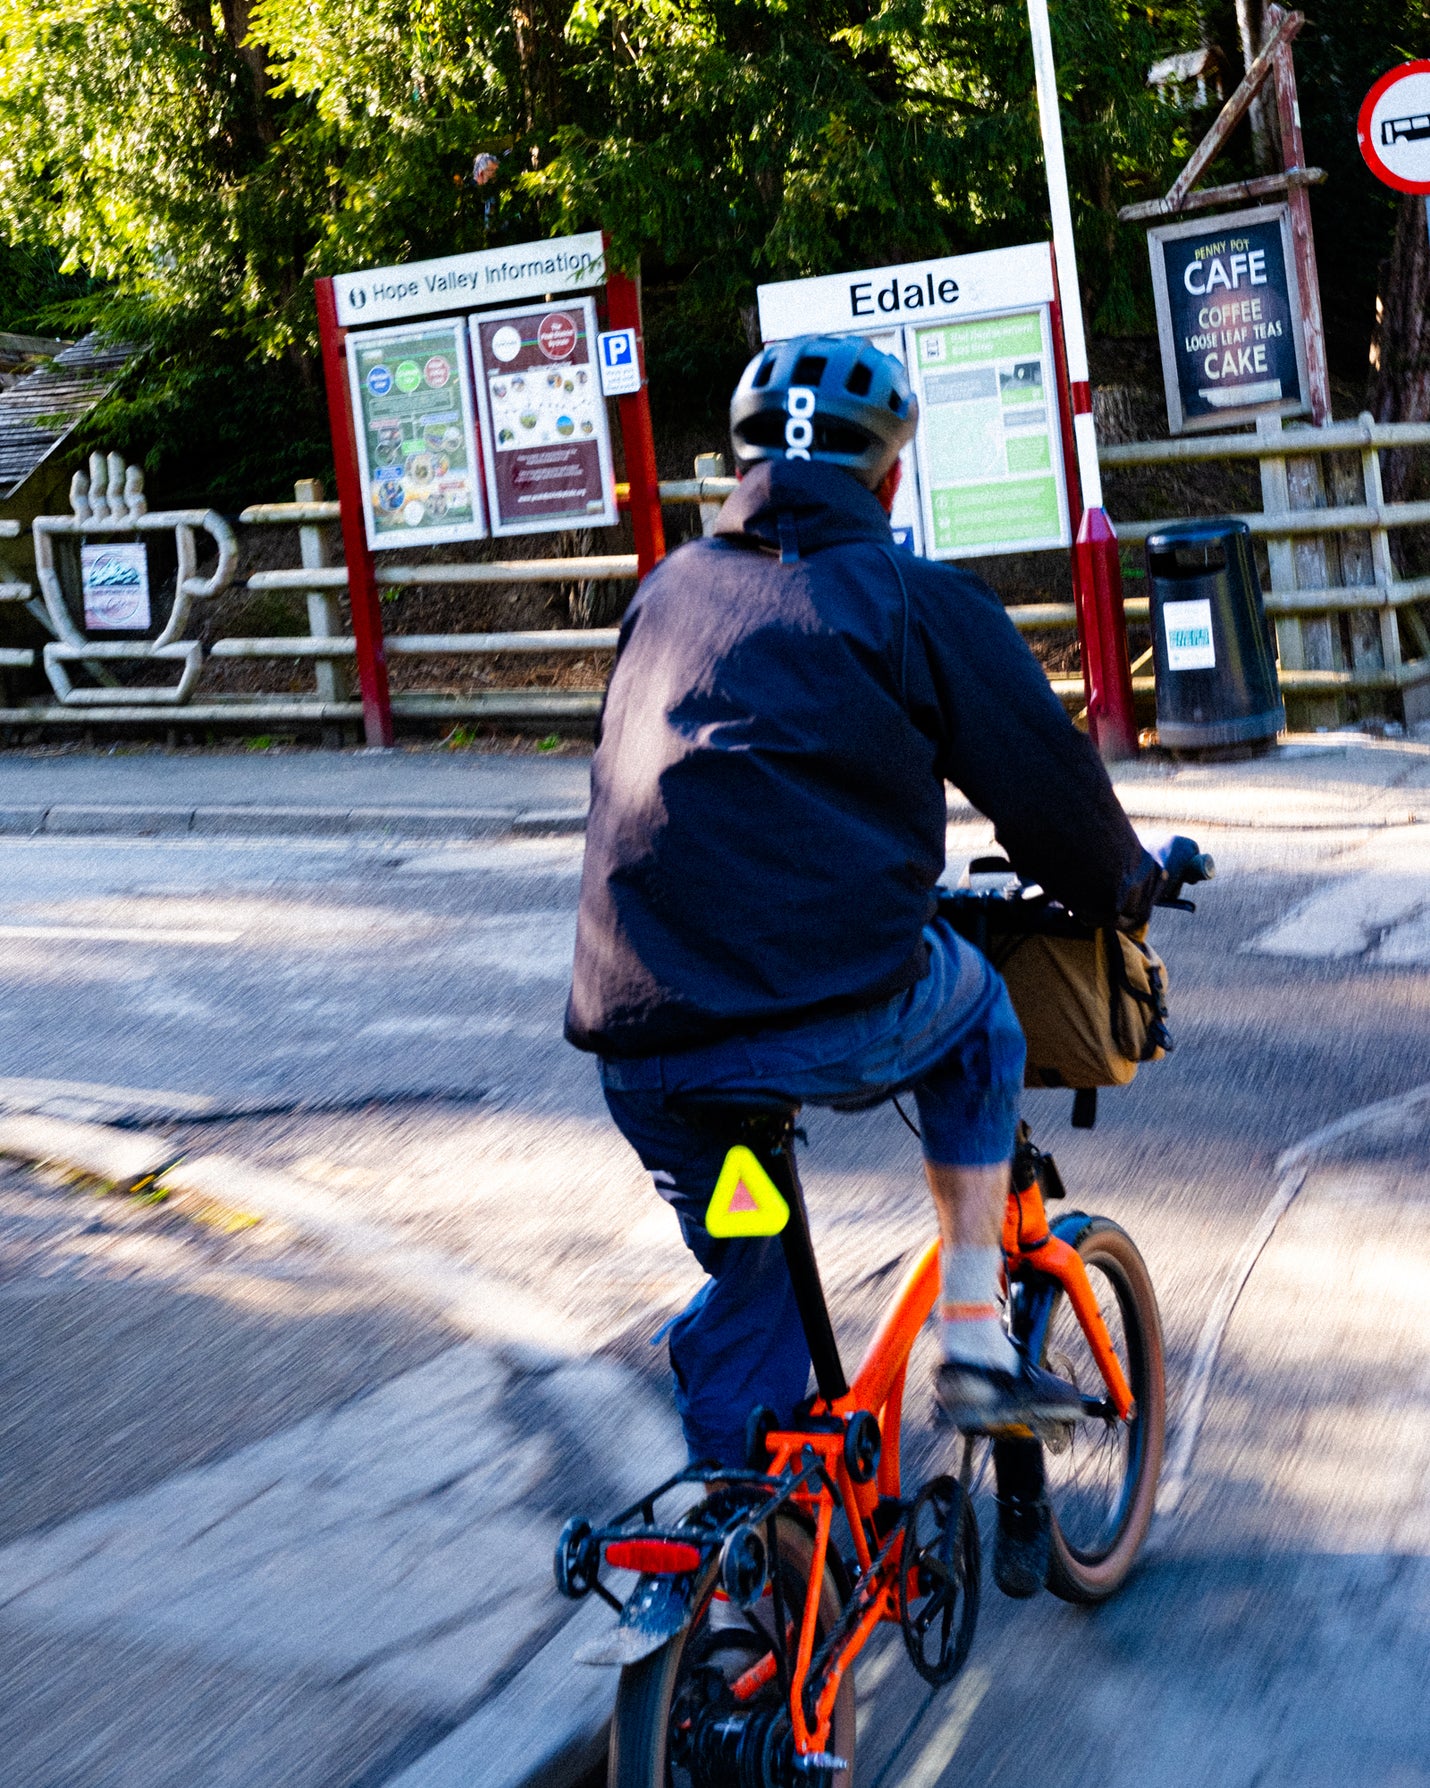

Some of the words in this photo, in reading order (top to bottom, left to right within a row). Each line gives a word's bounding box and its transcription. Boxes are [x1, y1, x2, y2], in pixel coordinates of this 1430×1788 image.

[1194, 241, 1226, 261] PENNY
[1230, 239, 1250, 252] POT
[372, 281, 419, 302] Hope
[424, 270, 478, 293] Valley
[485, 251, 592, 283] Information
[1184, 249, 1268, 295] CAFE
[850, 274, 960, 316] Edale
[1198, 298, 1262, 330] COFFEE
[608, 336, 628, 365] P
[1185, 335, 1218, 353] LOOSE
[1221, 328, 1249, 346] LEAF
[1253, 320, 1283, 340] TEAS
[1204, 344, 1268, 380] CAKE
